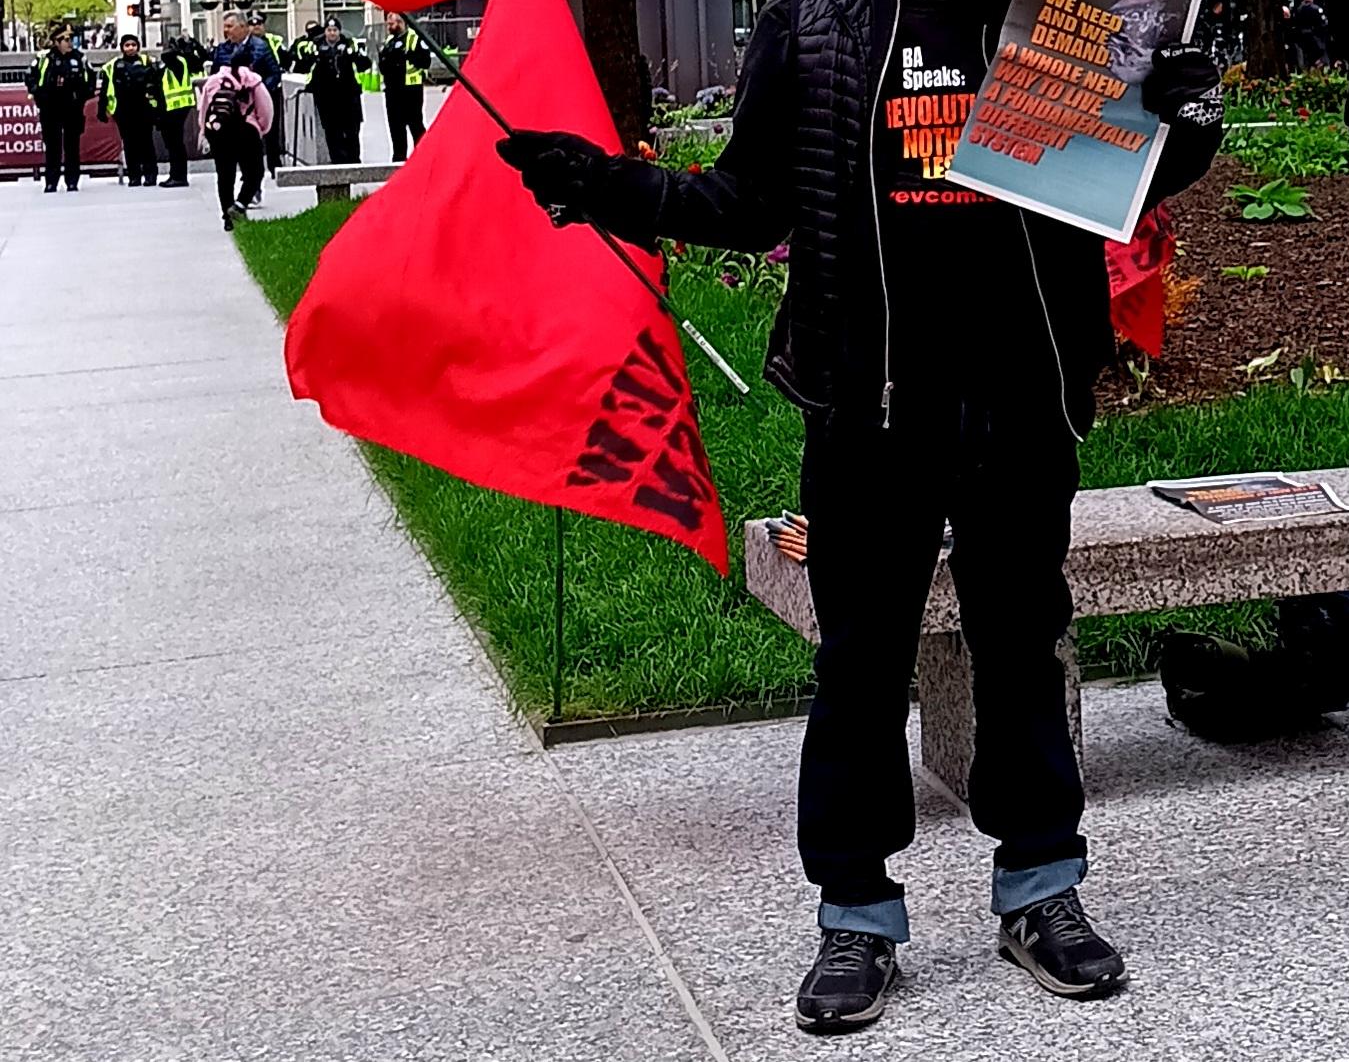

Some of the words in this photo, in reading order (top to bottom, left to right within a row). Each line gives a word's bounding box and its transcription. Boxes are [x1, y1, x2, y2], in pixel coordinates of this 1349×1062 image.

[1038, 6, 1077, 33] AND
[1081, 21, 1111, 45] WE
[1077, 1, 1123, 32] NEED
[902, 46, 924, 68] BA
[1031, 23, 1112, 68] DEMAND:
[902, 66, 966, 90] Speaks:
[993, 62, 1041, 90] WAY
[1040, 75, 1064, 101] TO
[1001, 41, 1018, 61] A
[1020, 47, 1084, 84] WHOLE
[1083, 70, 1128, 99] NEW
[976, 104, 1073, 151] DIFFERENT
[984, 82, 1000, 102] A
[1001, 87, 1149, 153] FUNDAMENTALLY
[969, 124, 1045, 165] SYSTEM
